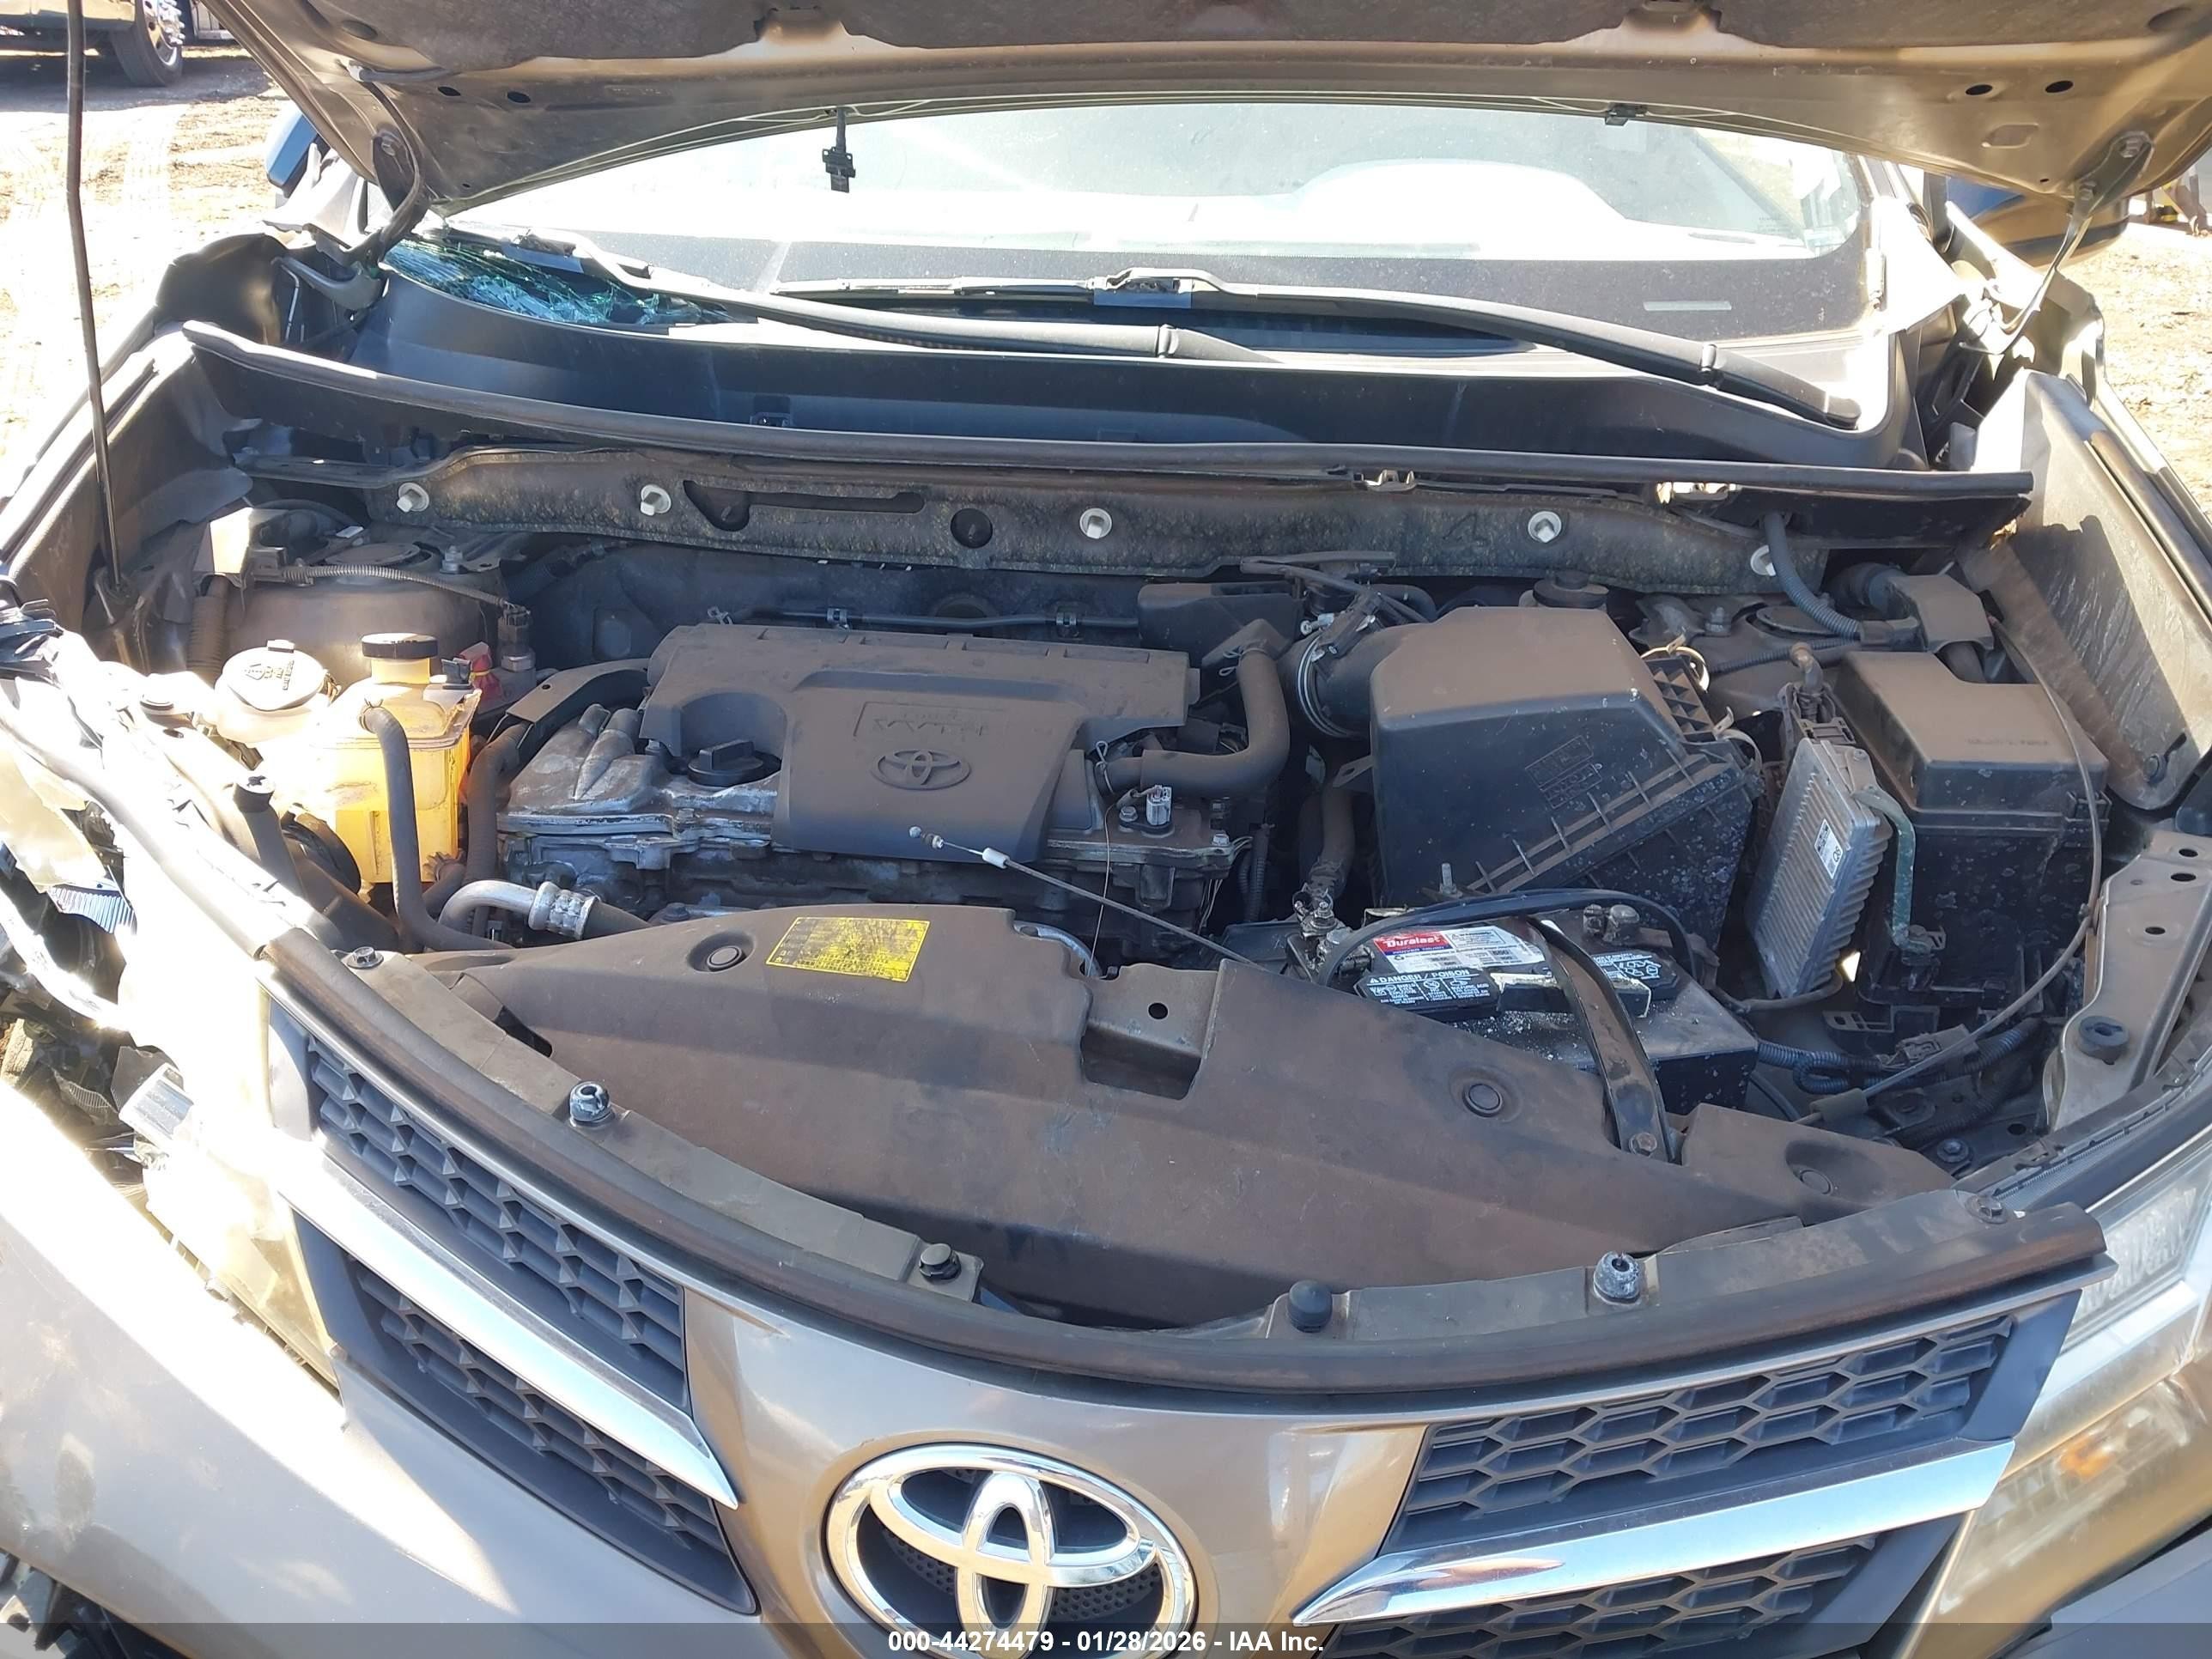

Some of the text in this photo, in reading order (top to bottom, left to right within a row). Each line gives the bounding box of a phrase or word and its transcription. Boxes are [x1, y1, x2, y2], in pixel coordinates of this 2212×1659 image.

[1383, 935, 1441, 948] Duralast
[1379, 973, 1422, 983] DANGER
[1431, 969, 1470, 978] POISON
